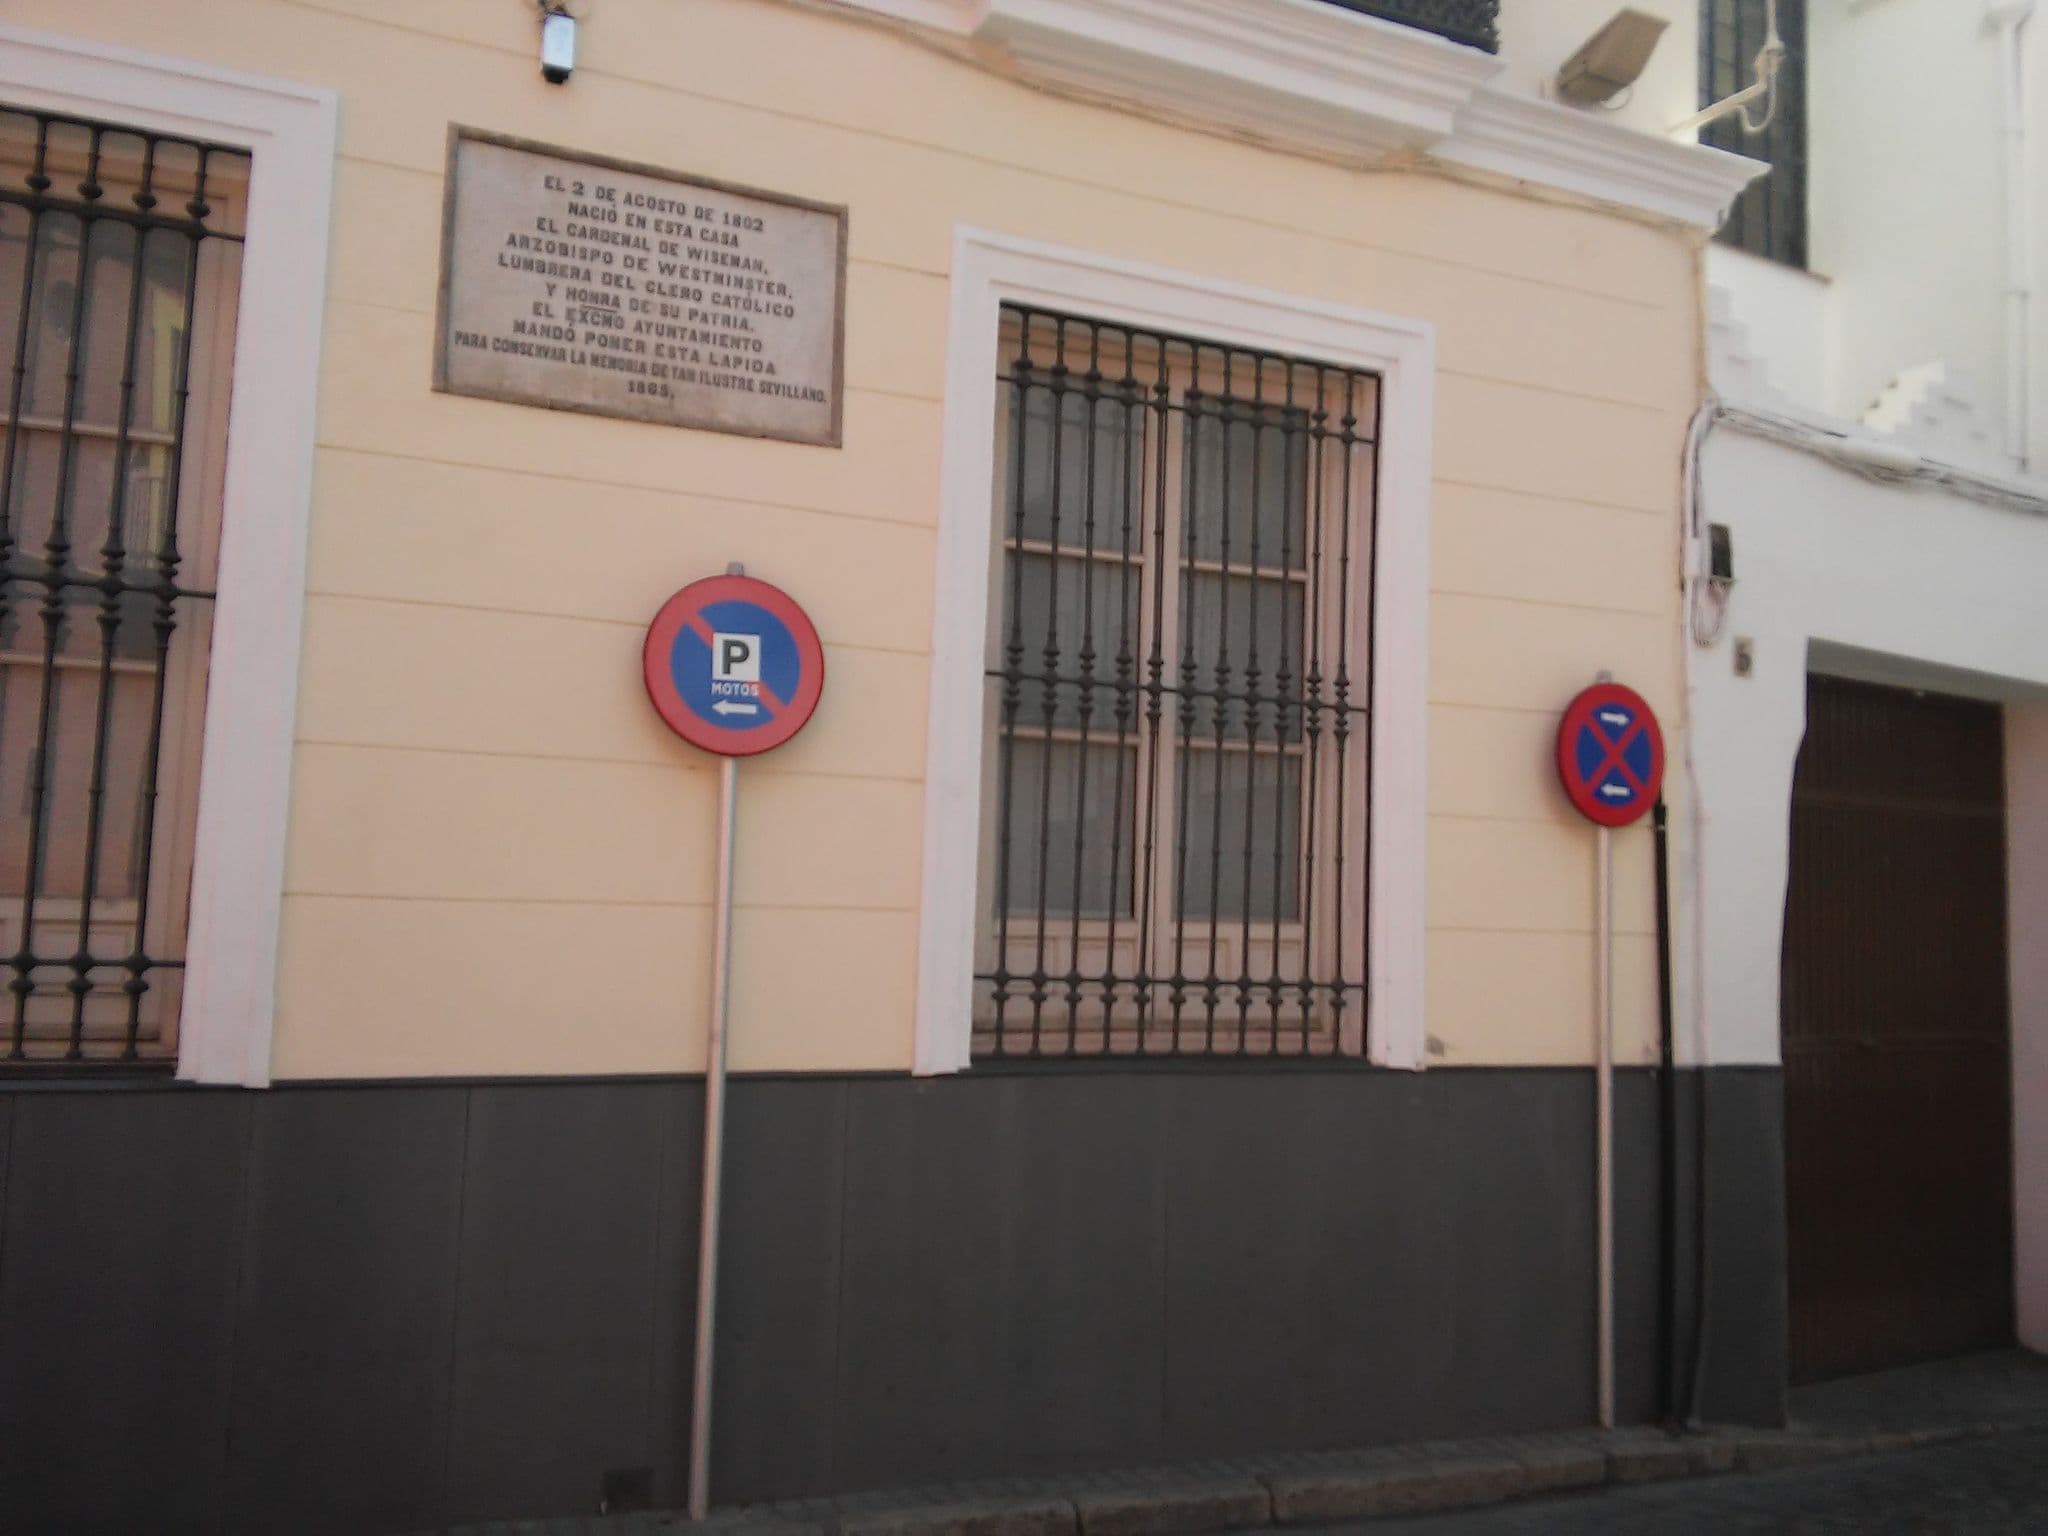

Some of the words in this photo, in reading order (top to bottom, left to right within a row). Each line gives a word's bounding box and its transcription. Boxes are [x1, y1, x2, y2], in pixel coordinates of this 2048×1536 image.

[544, 176, 565, 192] EL
[573, 182, 585, 195] 2
[596, 186, 617, 202] DE
[694, 206, 714, 221] DE
[536, 217, 558, 234] EL
[566, 223, 650, 250] CARDENAL
[659, 239, 680, 256] DE
[625, 213, 647, 230] EN
[654, 219, 692, 238] ESTA
[700, 229, 739, 248] CASA
[507, 234, 612, 263] ARZOBISPO
[624, 254, 648, 271] DE
[498, 253, 592, 282] LUMBRERA
[601, 272, 635, 291] DEL
[645, 280, 703, 301] CLERO
[545, 283, 556, 297] Y
[566, 287, 620, 308] HONRA
[630, 298, 652, 313] DE
[660, 304, 681, 320] SU
[532, 302, 554, 318] EL
[634, 319, 763, 353] AYUNTAMIENTO
[455, 331, 487, 349] PARA
[492, 337, 566, 363] CONSERVAR
[571, 350, 587, 365] LA
[591, 353, 647, 376] MEMORIA
[651, 361, 669, 376] DE
[672, 364, 695, 381] TAN
[700, 369, 754, 392] ILUSTRE
[585, 332, 646, 355] PONER
[654, 343, 700, 364] ESTA
[722, 639, 750, 674] P
[711, 682, 760, 697] MOTOS
